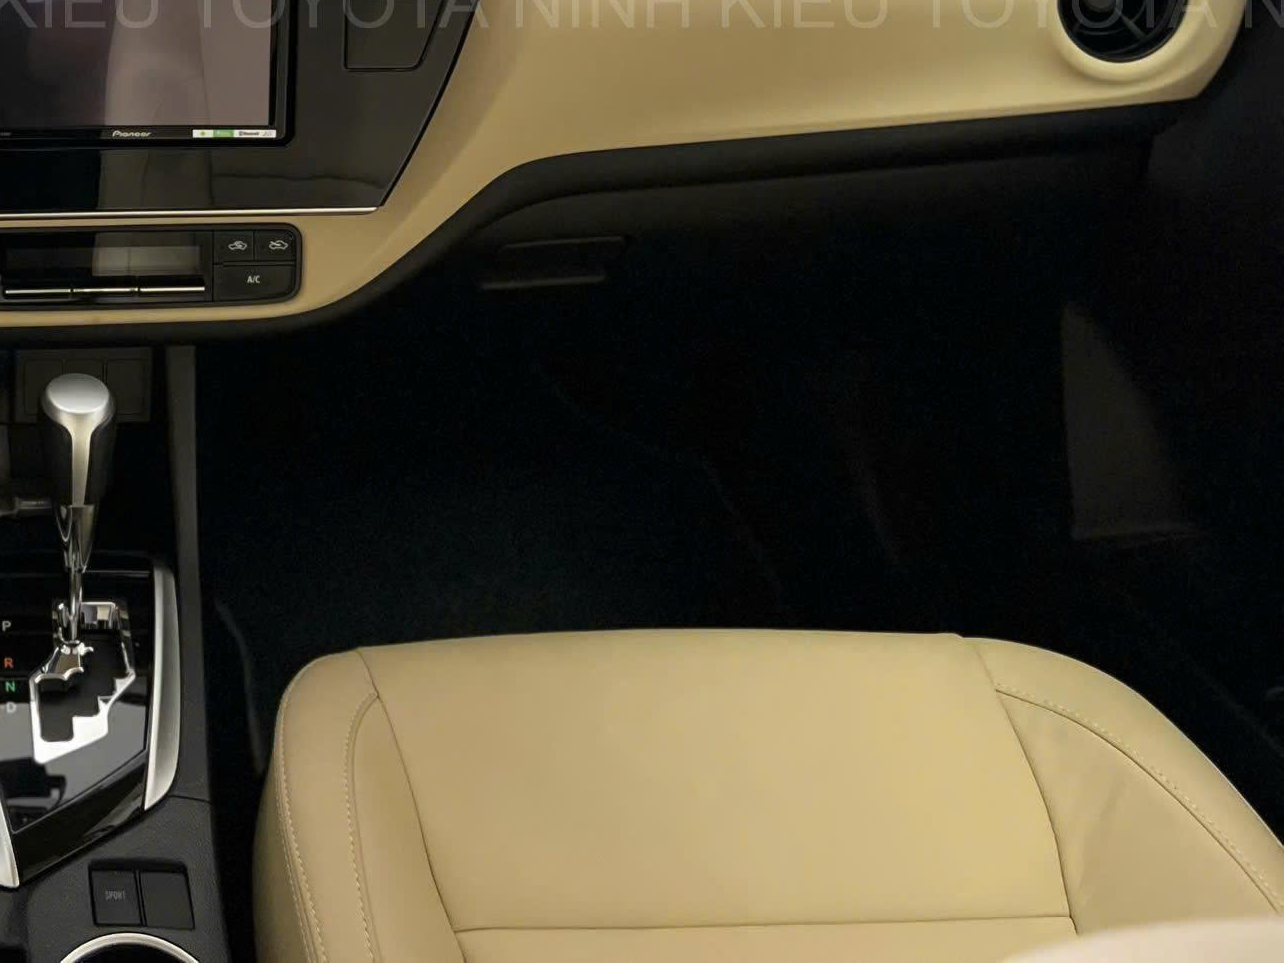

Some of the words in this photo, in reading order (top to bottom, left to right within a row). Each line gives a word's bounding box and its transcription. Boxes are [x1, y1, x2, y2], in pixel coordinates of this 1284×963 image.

[247, 275, 261, 284] A/C
[1, 620, 12, 632] P
[3, 657, 14, 669] R
[5, 680, 16, 692] N
[5, 701, 17, 713] D
